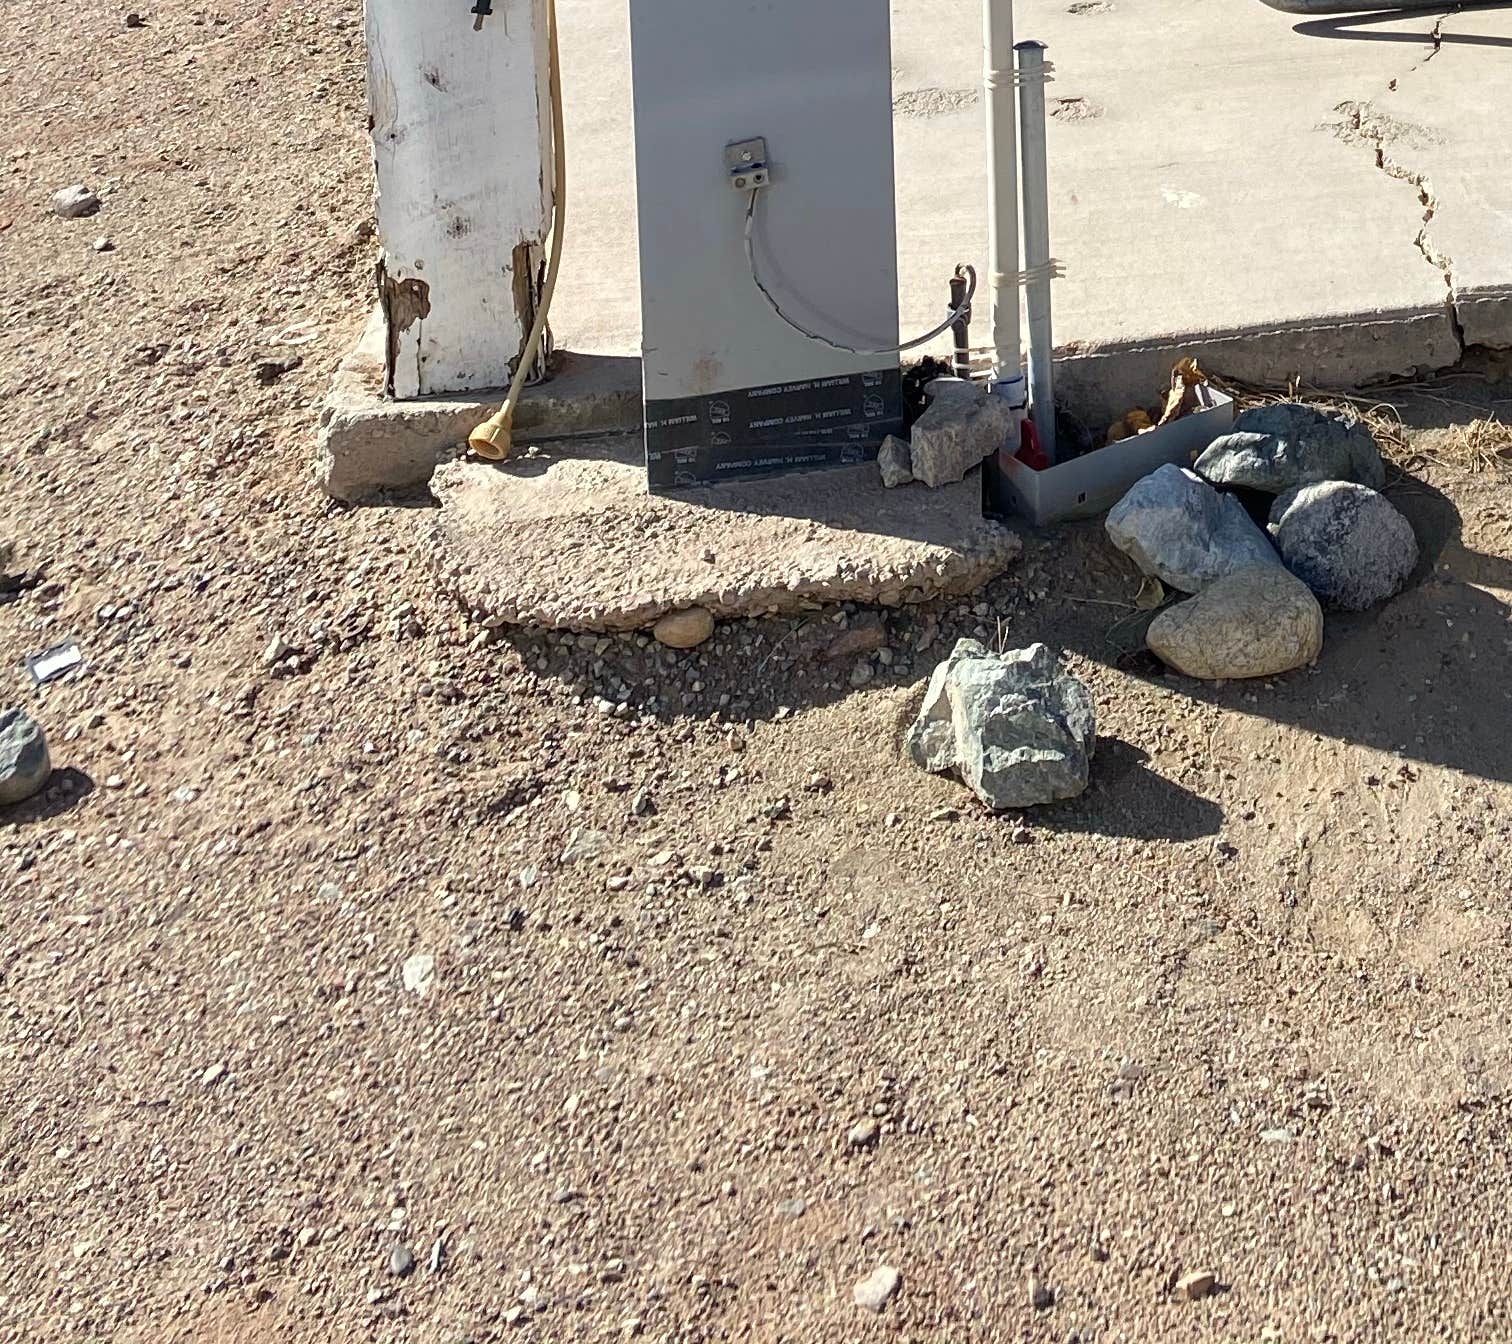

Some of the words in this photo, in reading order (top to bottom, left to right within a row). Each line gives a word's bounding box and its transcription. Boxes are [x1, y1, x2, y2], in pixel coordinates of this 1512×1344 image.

[784, 383, 810, 393] HARVEY
[822, 378, 850, 388] WILLIAM
[748, 387, 782, 397] COMPANY
[785, 413, 813, 423] HARVEY
[823, 409, 852, 419] WILLIAM
[668, 415, 697, 425] WILLIAM
[750, 417, 784, 428] COMPANY
[754, 457, 784, 467] HARVEY
[795, 454, 826, 463] WILLIAM
[715, 461, 752, 470] COMPANY
